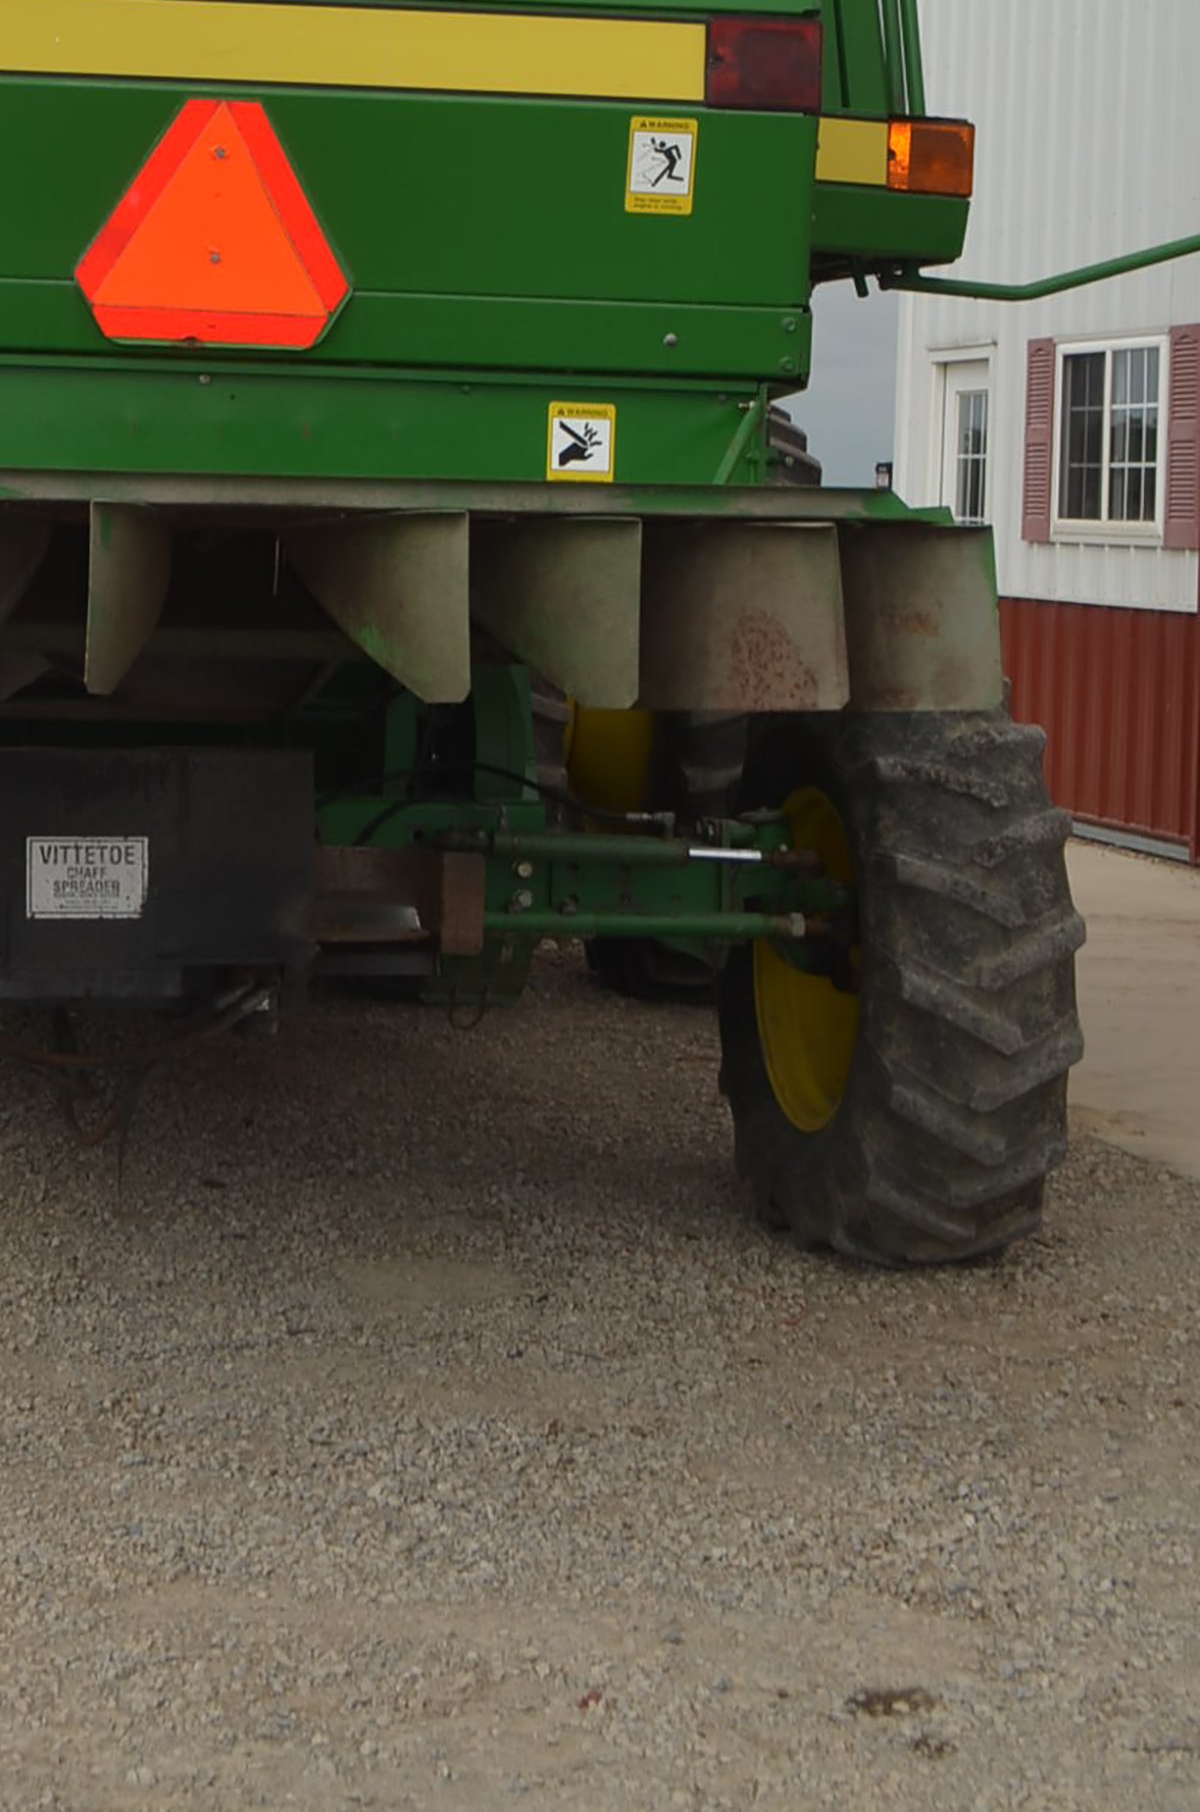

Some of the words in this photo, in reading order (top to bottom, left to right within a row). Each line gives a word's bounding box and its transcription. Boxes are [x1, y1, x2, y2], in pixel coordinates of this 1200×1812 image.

[39, 844, 136, 865] VITTETOE
[66, 866, 107, 880] CHAFF
[52, 879, 121, 894] SPREADER
